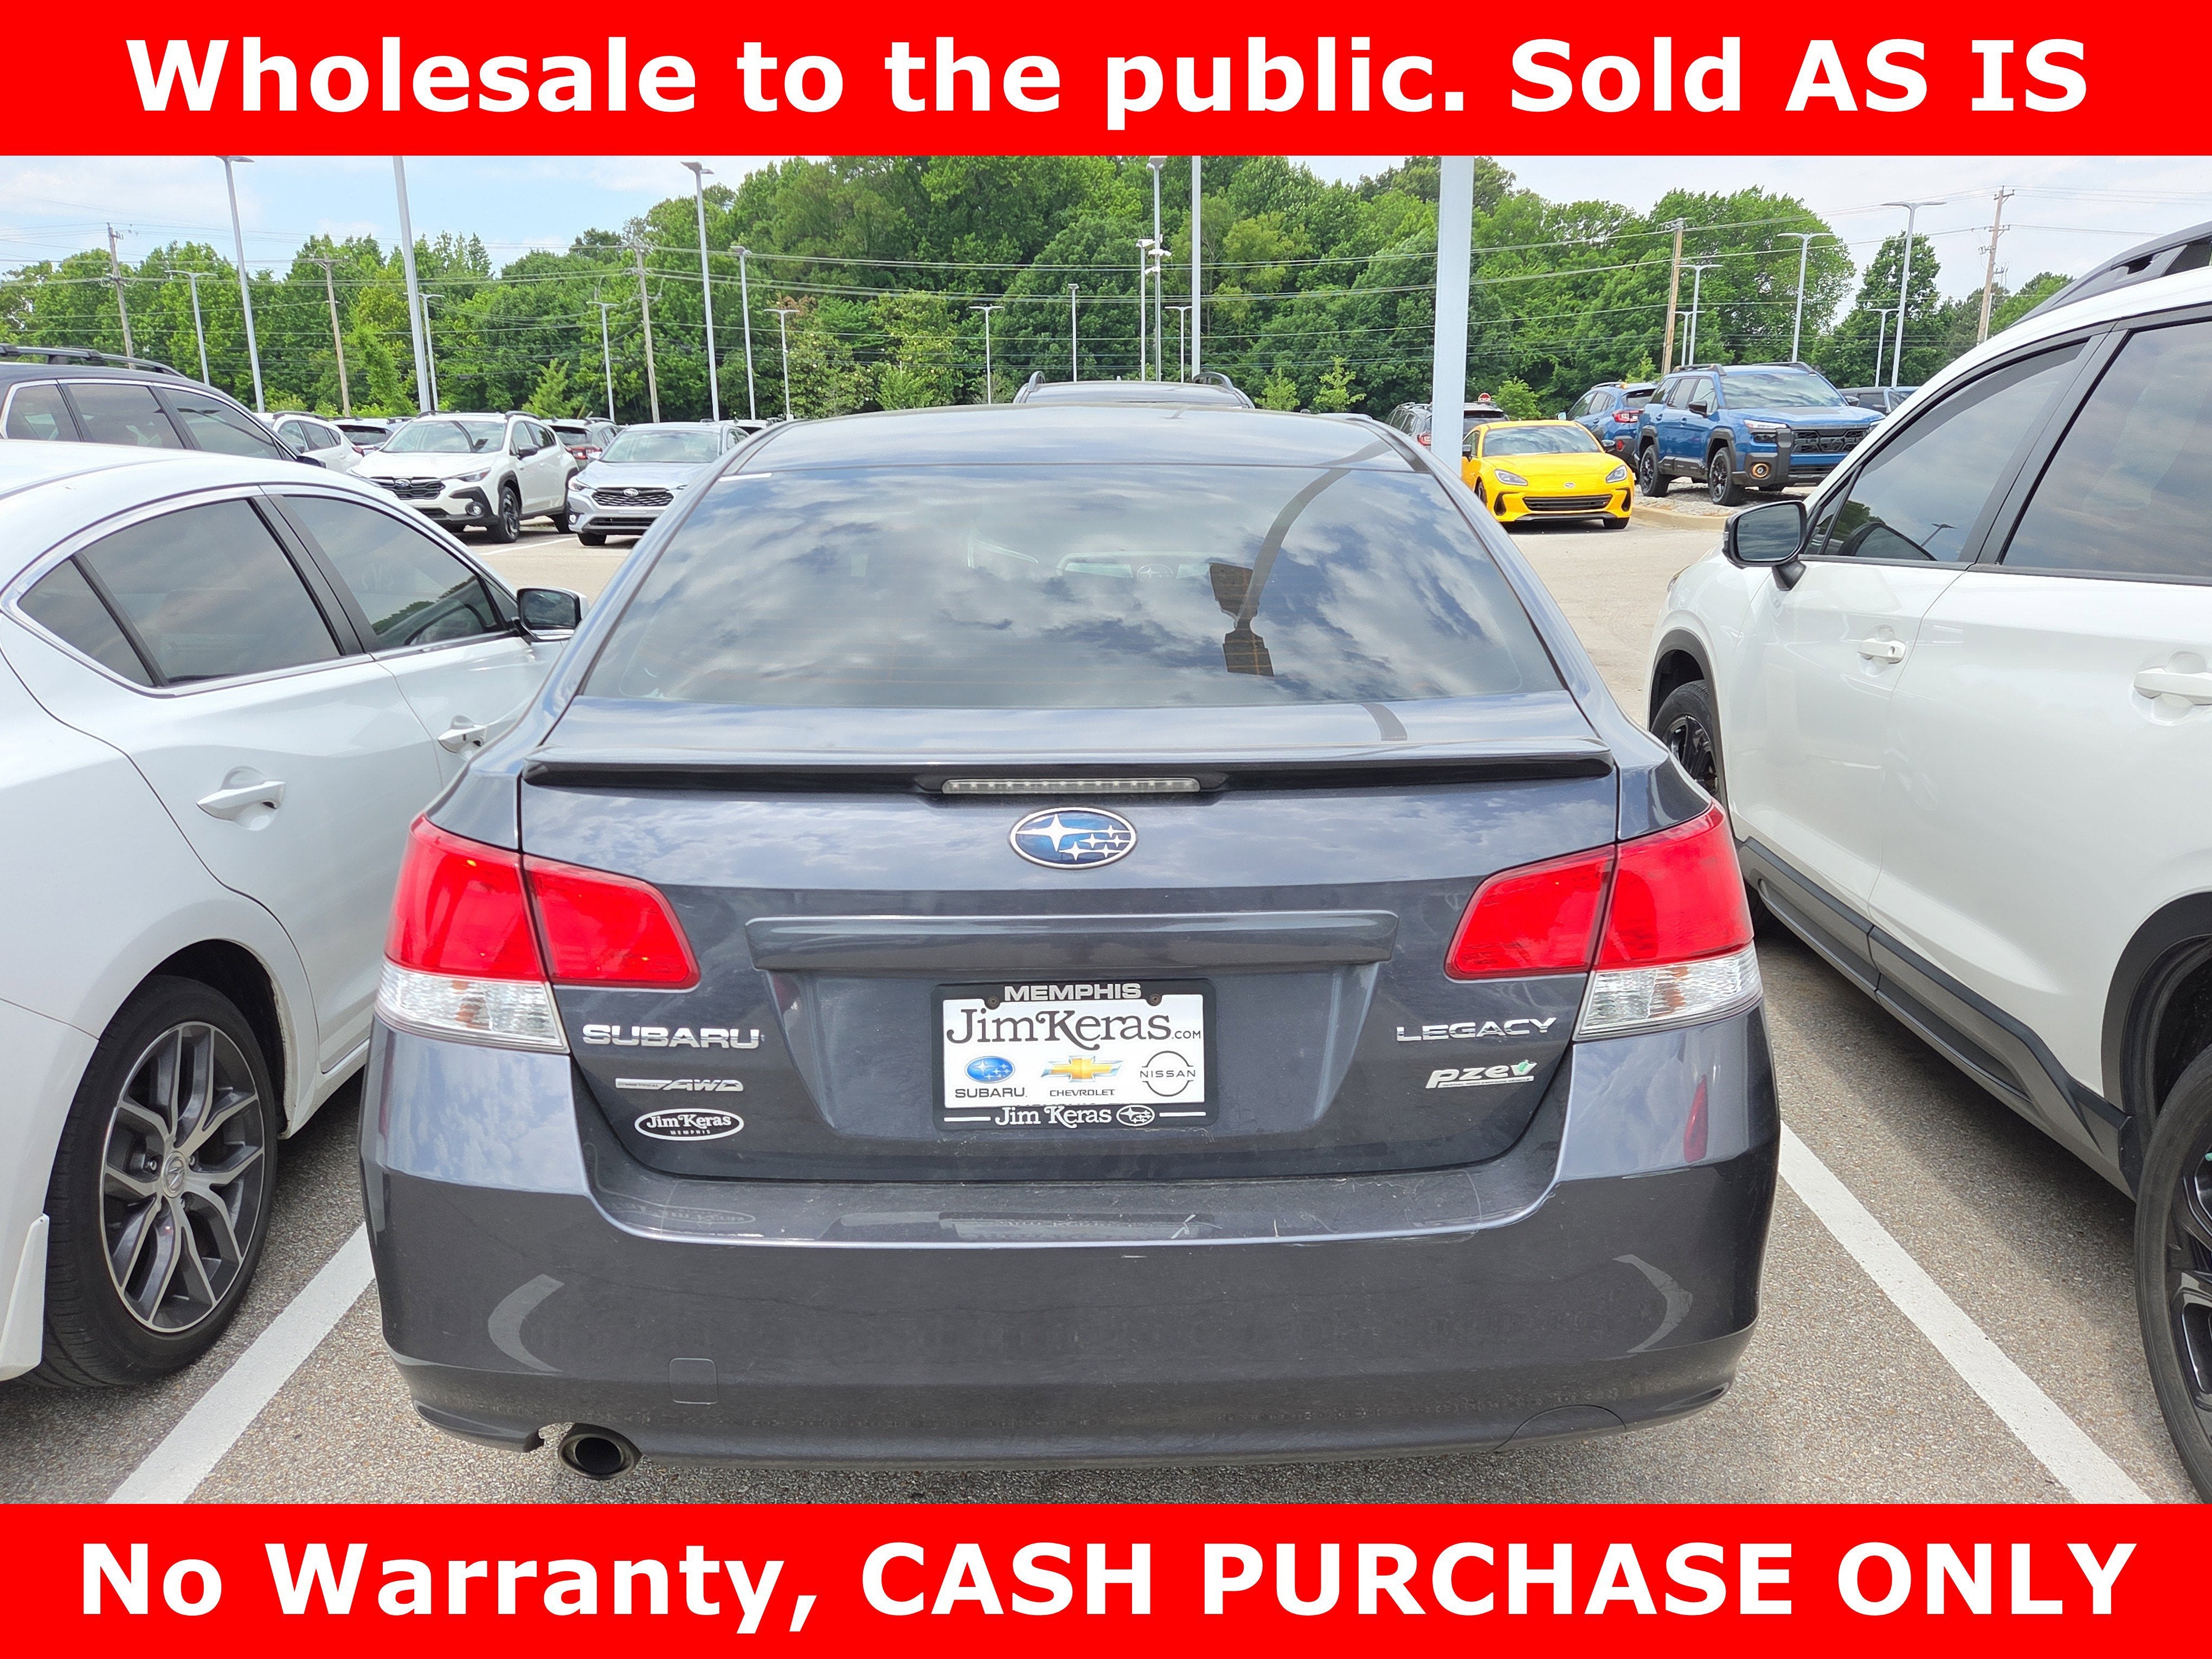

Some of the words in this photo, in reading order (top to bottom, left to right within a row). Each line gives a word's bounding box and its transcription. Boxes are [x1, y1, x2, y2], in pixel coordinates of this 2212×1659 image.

[1005, 983, 1141, 1001] MEMPHIS
[583, 1024, 760, 1049] SUBARU
[1397, 1017, 1557, 1041] LEGACY
[1140, 1070, 1196, 1078] NISSAN
[663, 1079, 743, 1091] AWD
[955, 1087, 1025, 1098] SUBARU
[1050, 1089, 1115, 1097] CHEVROLET
[995, 1107, 1041, 1126] Jim
[1044, 1105, 1112, 1128] Keras
